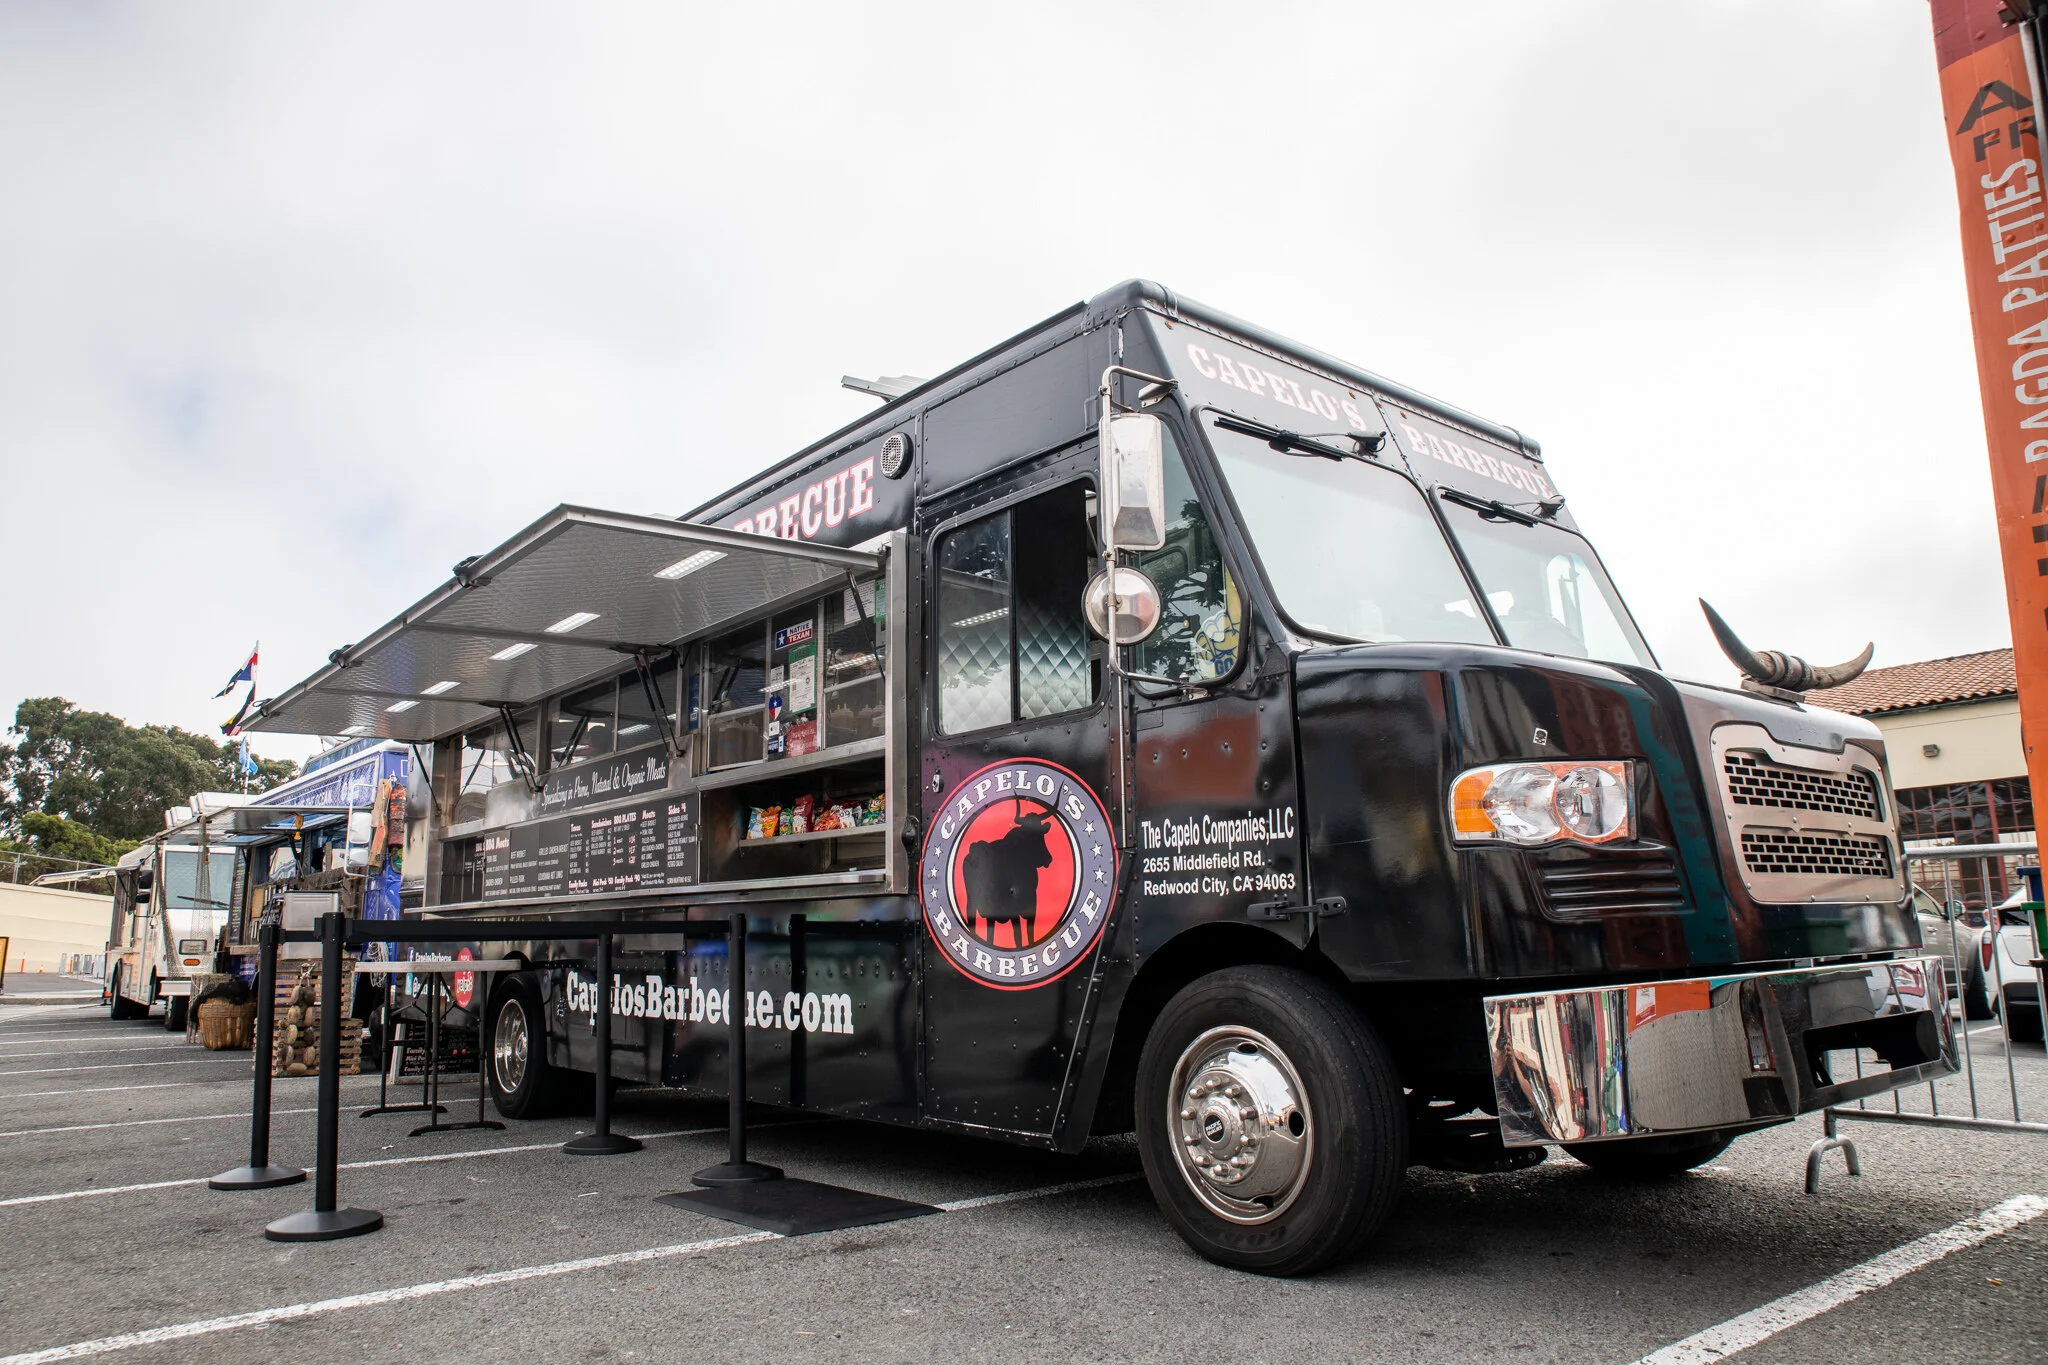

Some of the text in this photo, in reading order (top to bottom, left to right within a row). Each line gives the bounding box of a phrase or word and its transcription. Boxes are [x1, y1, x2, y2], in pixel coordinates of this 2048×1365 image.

[1981, 159, 2048, 311] PATTIES
[1186, 343, 1367, 432] CAPELO'S
[1400, 422, 1553, 499] BARBECUE
[733, 456, 875, 540] BECUE
[788, 630, 811, 643] TEXAN
[789, 621, 810, 635] NATIVE
[541, 781, 568, 811] Specializing
[567, 783, 573, 800] in
[591, 765, 613, 795] Natural
[612, 766, 621, 790] &
[621, 762, 646, 793] Organic
[646, 757, 667, 782] Meats
[939, 769, 1086, 841] CAPELO'S
[622, 812, 637, 823] PLATES
[1141, 820, 1160, 850] The
[1163, 818, 1200, 855] Capelo
[1143, 849, 1266, 873] 2655 Middlefield Rd.
[1143, 872, 1296, 896] Redwood City, CA 94063
[933, 889, 1101, 978] BARBECUE
